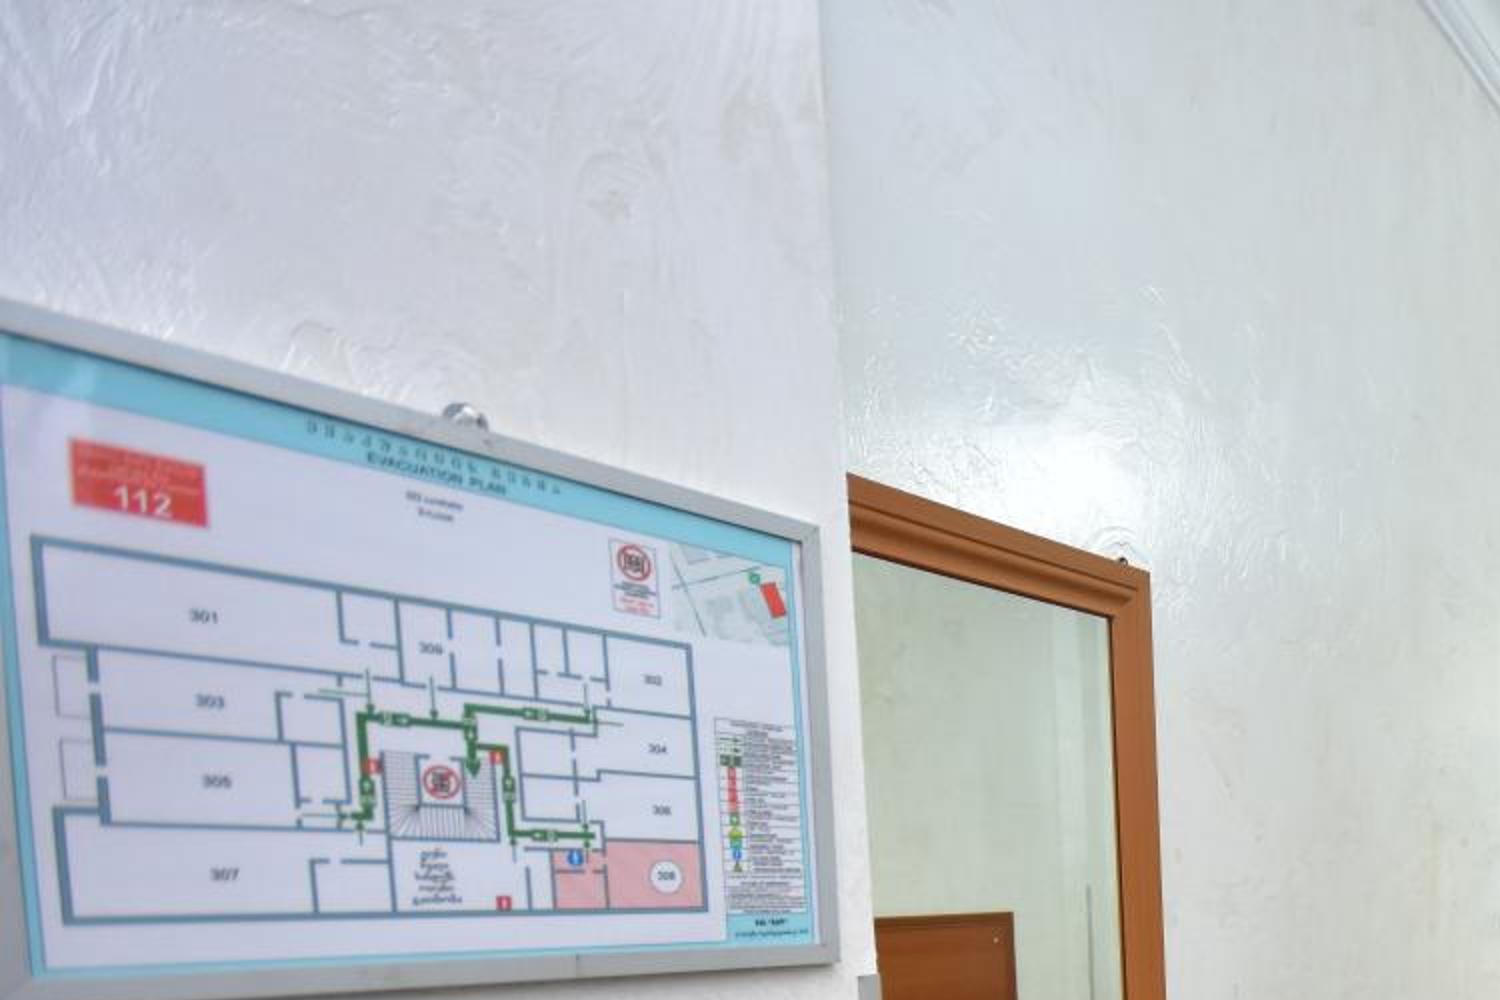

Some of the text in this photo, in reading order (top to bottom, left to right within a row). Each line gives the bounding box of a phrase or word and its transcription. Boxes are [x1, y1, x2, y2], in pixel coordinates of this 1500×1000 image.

[367, 451, 463, 486] EVACUATION
[468, 475, 507, 497] PLAN
[113, 484, 173, 519] 112
[190, 609, 219, 624] 301
[195, 694, 225, 709] 303
[210, 867, 239, 882] 307
